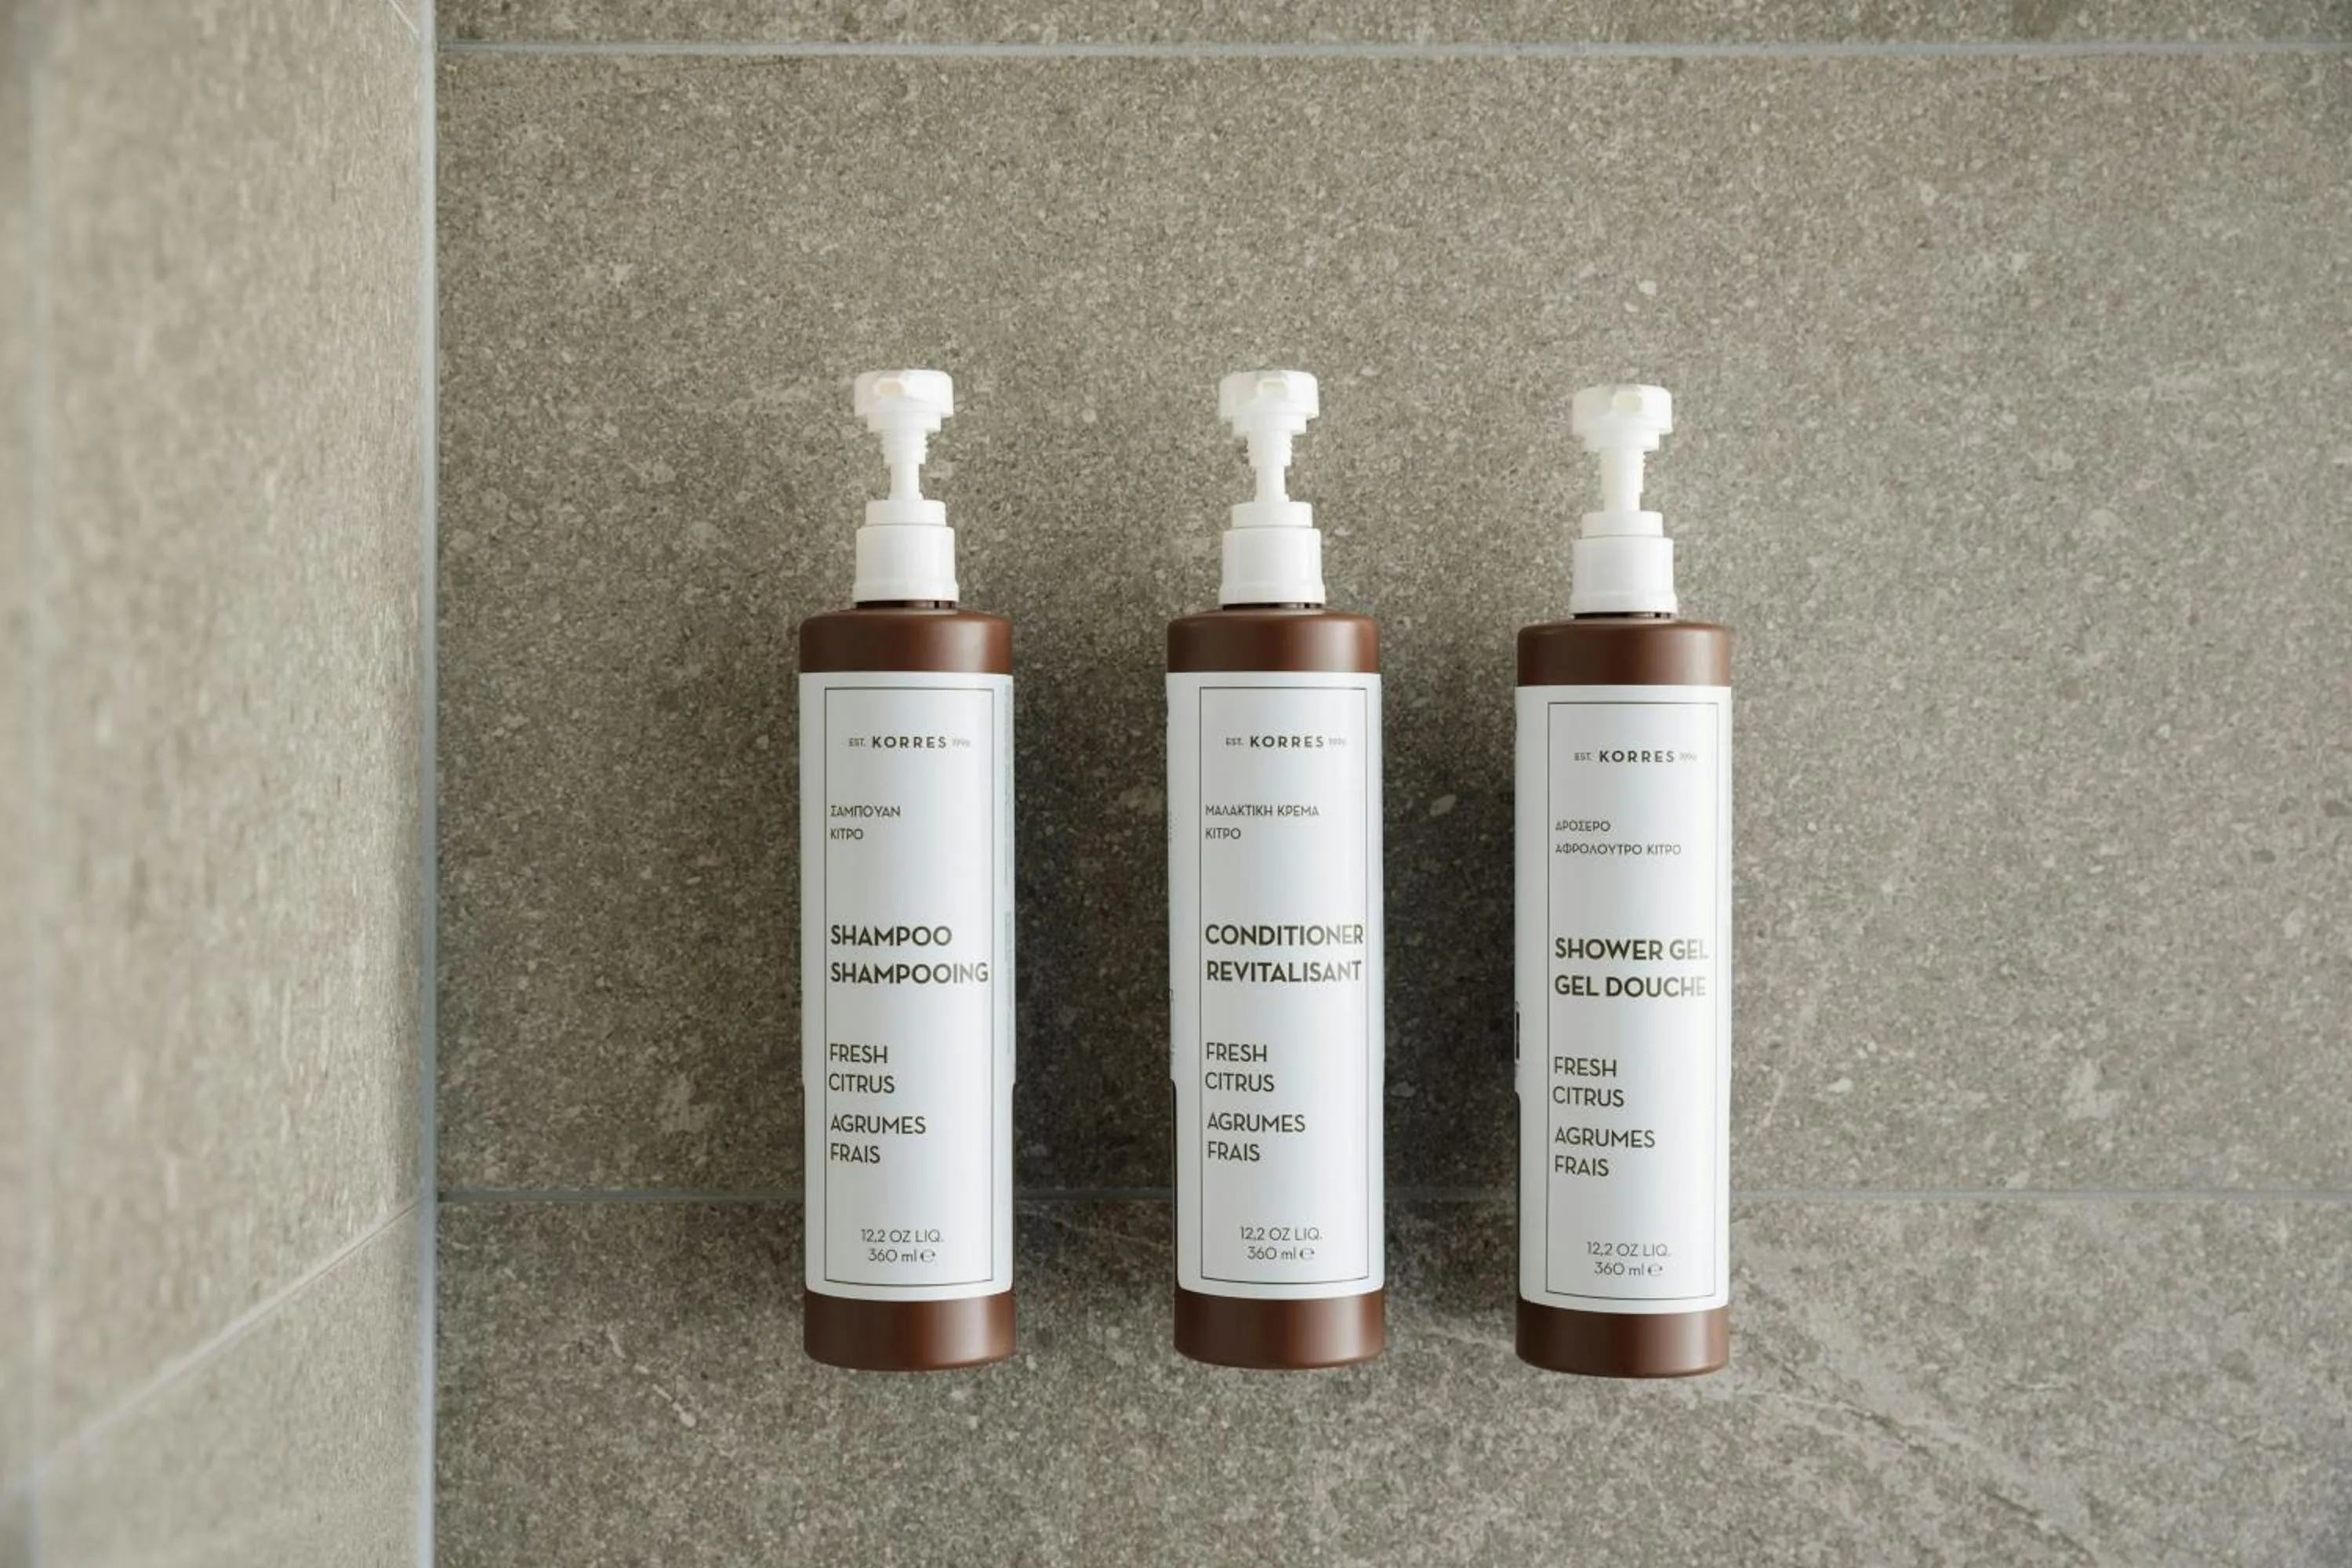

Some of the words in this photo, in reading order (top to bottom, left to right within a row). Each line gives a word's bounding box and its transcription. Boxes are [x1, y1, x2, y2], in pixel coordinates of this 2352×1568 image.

[872, 735, 947, 750] KORRES
[1250, 735, 1325, 749] KORRES
[1599, 750, 1675, 763] KORRES
[830, 804, 902, 818] ΣΑΜΠΟΥΑΝ
[1205, 803, 1273, 817] ΜΑΛΑΚΤΙΚΗ
[1277, 804, 1320, 817] ΚΡΕΜΑ
[830, 827, 864, 841] ΚΙΤΡΟ
[1205, 827, 1241, 840] ΚΙΤΡΟ
[1555, 844, 1642, 855] ΑΦΡΟΛΟΥΤΡΟ
[1646, 844, 1682, 856] ΚΙΤΡΟ
[830, 924, 953, 947] SHAMPOO
[1205, 924, 1364, 946] CONDITIONER
[1555, 937, 1664, 960] SHOWER
[1669, 939, 1709, 960] GEL
[830, 961, 989, 985] SHAMPOOING
[1206, 960, 1363, 983] REVITALISANT
[1555, 975, 1599, 996] GEL
[1605, 976, 1707, 998] DOUCHE
[829, 1043, 888, 1064] FRESH
[1206, 1042, 1268, 1062] FRESH
[1554, 1056, 1617, 1077] FRESH
[828, 1072, 895, 1094] CITRUS
[1205, 1071, 1275, 1092] CITRUS
[1553, 1086, 1625, 1108] CITRUS
[830, 1113, 927, 1134] AGRUMES
[1207, 1111, 1306, 1133] AGRUMES
[1555, 1126, 1656, 1149] AGRUMES
[830, 1142, 880, 1164] FRAIS
[1207, 1141, 1261, 1162] FRAIS
[1555, 1156, 1610, 1177] FRAIS
[889, 1229, 912, 1243] OZ
[1269, 1227, 1291, 1241] OZ
[868, 1247, 898, 1263] 360
[901, 1248, 917, 1263] ml
[1247, 1246, 1277, 1260] 360
[1280, 1247, 1297, 1261] ml
[1616, 1243, 1639, 1257] OZ
[1594, 1261, 1625, 1276] 360
[1628, 1262, 1645, 1276] ml
